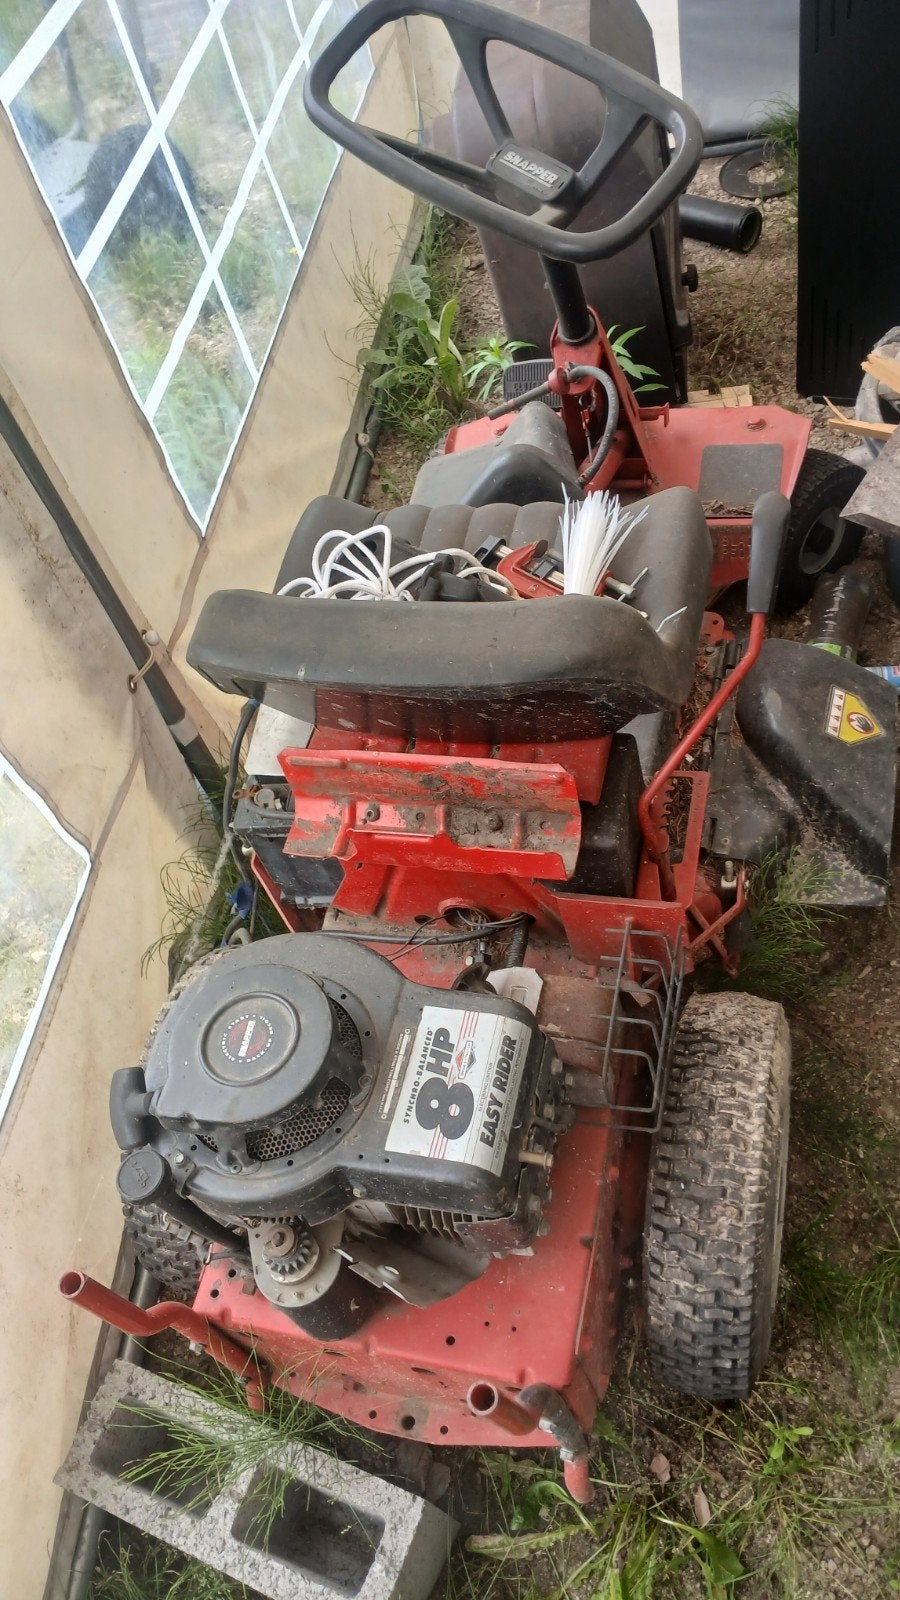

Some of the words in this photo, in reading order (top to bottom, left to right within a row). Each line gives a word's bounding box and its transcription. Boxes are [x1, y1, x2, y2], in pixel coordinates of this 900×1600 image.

[503, 151, 559, 184] SNAPPER
[403, 1028, 434, 1124] SYNCHRO-BALANCED
[425, 1027, 456, 1077] HP
[415, 1076, 475, 1140] 8
[480, 1092, 503, 1148] EASY
[492, 1034, 518, 1094] RIDER
